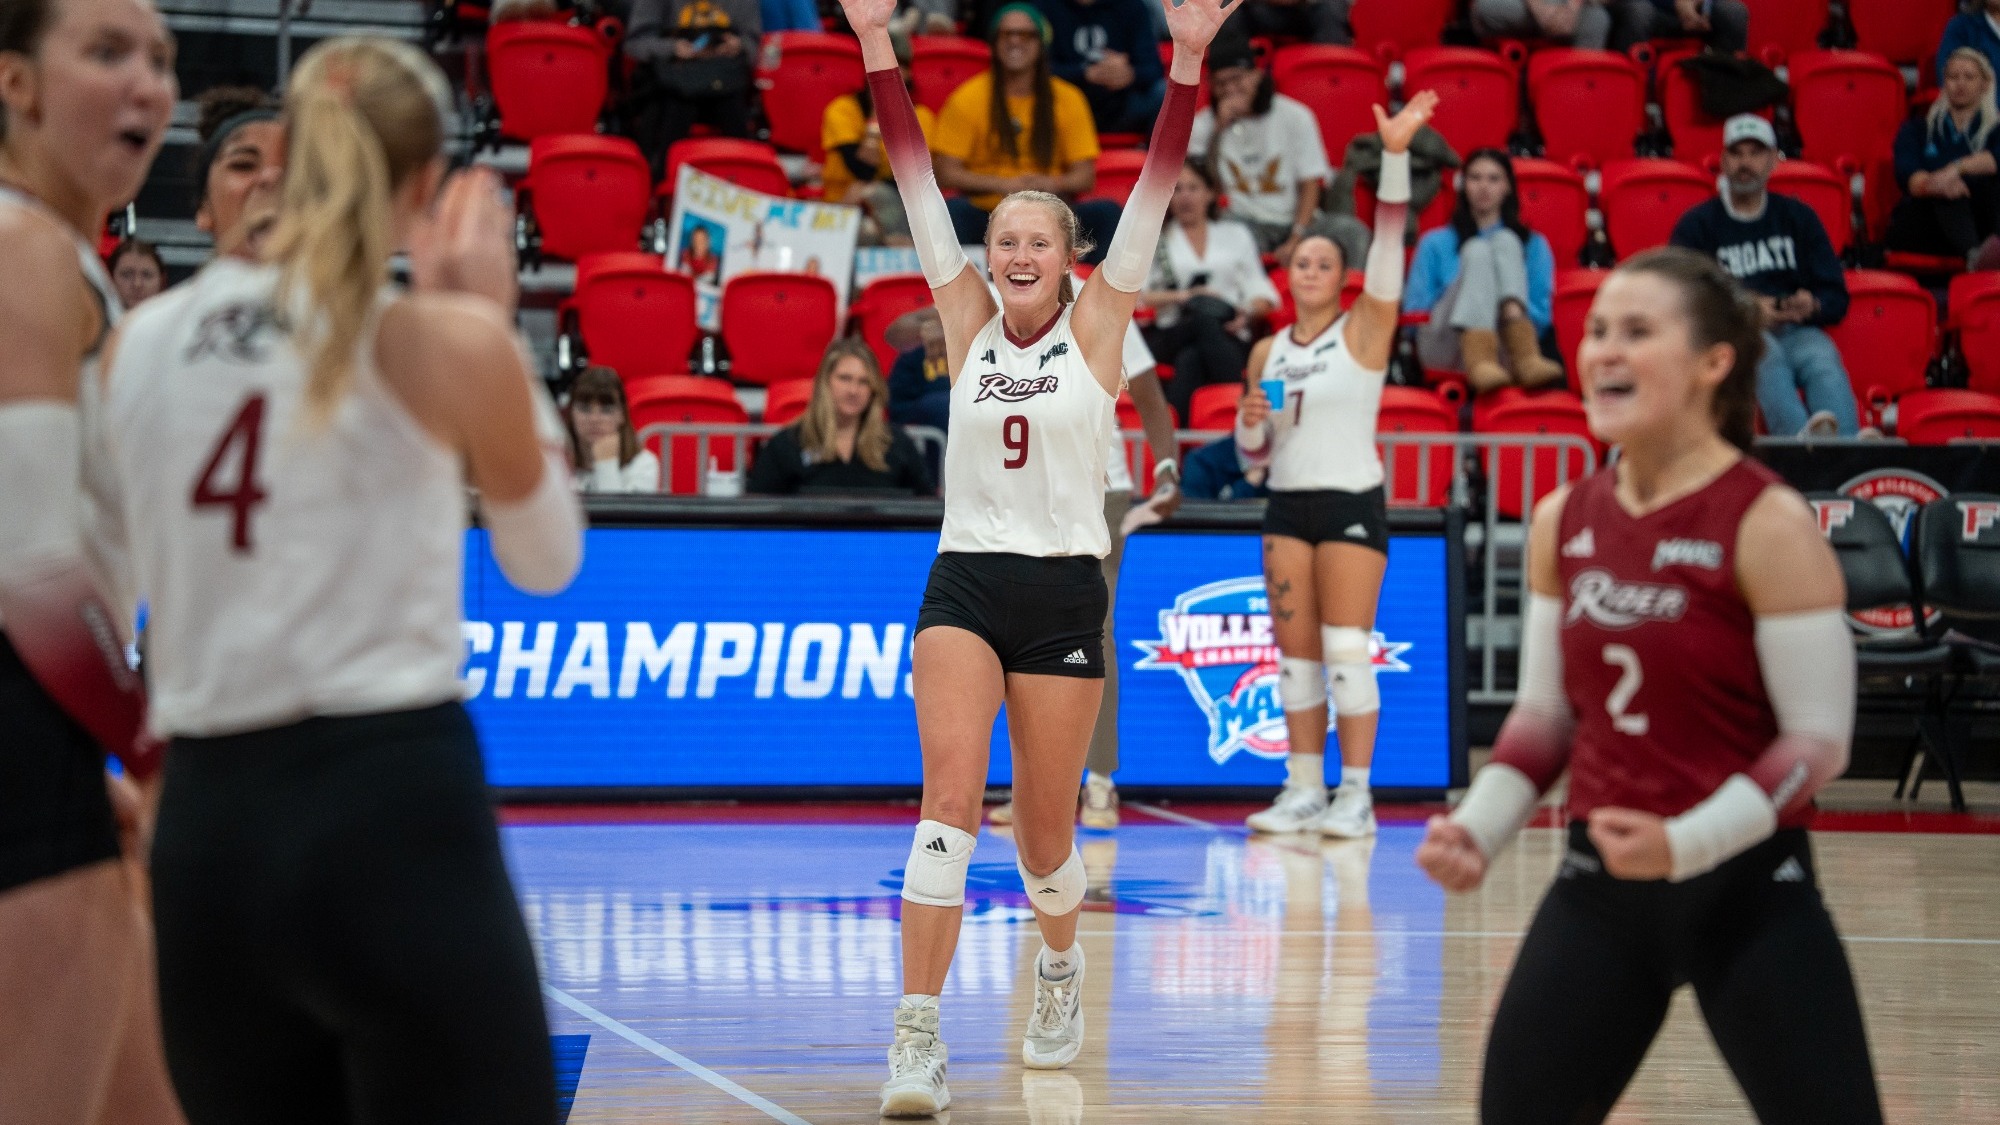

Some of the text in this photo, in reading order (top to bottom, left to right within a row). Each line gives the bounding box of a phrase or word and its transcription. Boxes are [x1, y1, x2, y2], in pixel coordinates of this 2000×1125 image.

[973, 372, 1059, 403] RIDER
[1287, 388, 1305, 426] 7
[1003, 414, 1029, 469] 9
[188, 391, 271, 554] 4
[1810, 500, 1854, 541] F
[1956, 500, 2000, 541] F
[1563, 567, 1688, 630] RIDER
[1166, 614, 1275, 654] VOLLE
[460, 621, 914, 699] CHAMPION
[1063, 657, 1088, 665] adidas
[1602, 643, 1649, 736] 2
[1218, 685, 1285, 745] MA
